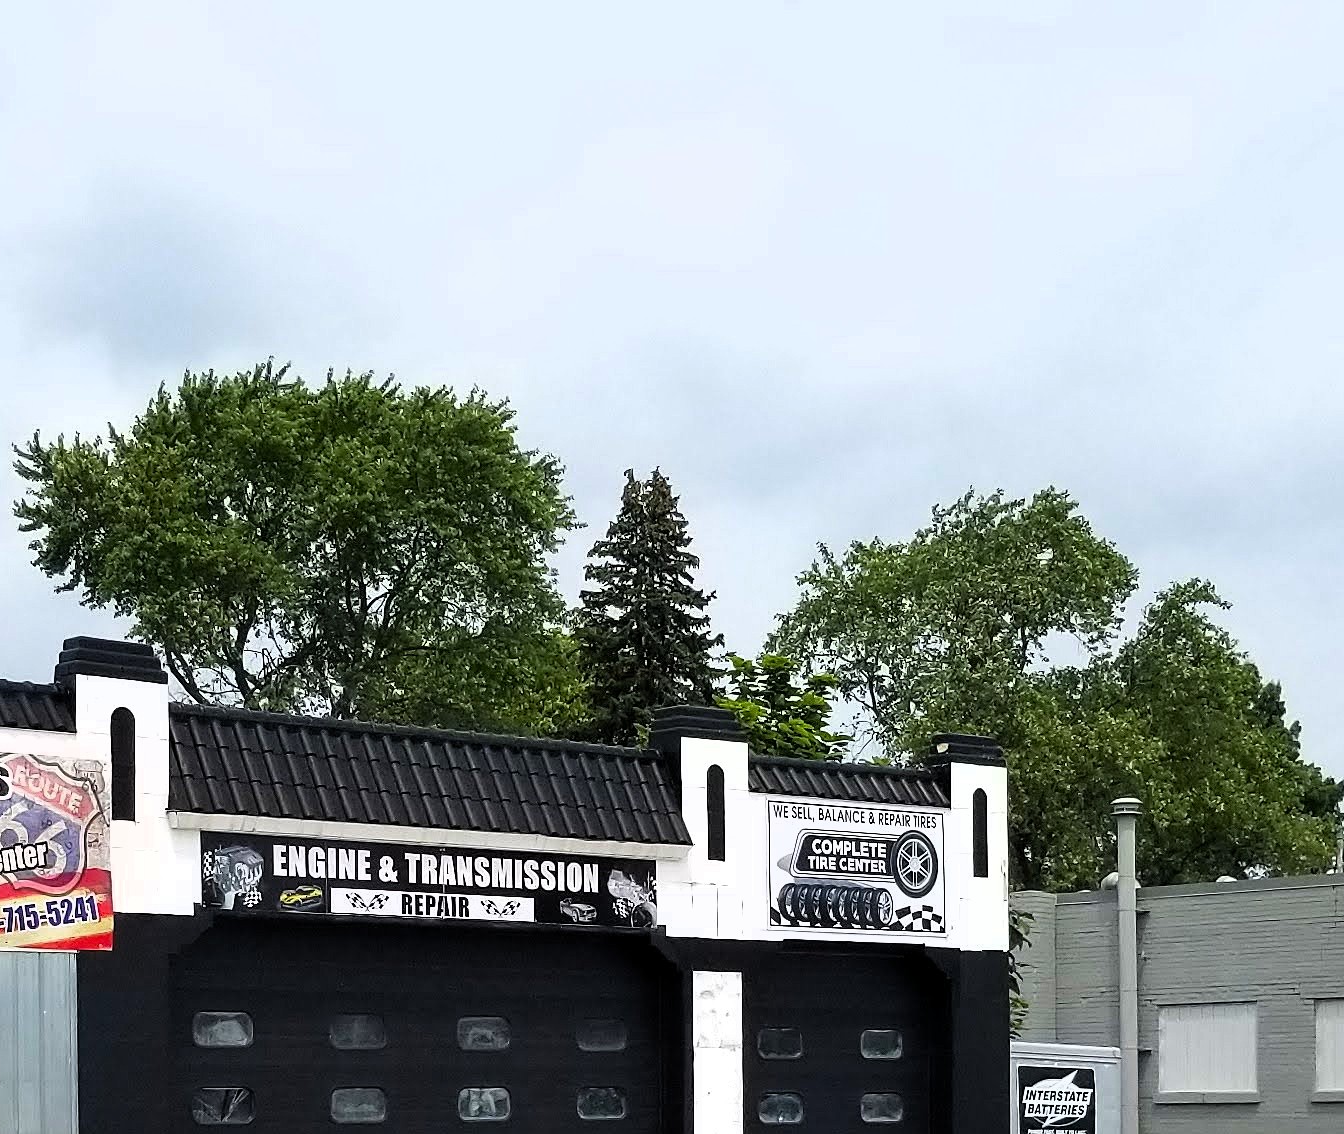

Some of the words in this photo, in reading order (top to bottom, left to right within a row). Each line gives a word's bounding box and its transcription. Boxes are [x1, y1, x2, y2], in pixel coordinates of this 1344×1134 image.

[13, 765, 83, 814] ROUTE
[773, 805, 789, 819] WE
[791, 807, 815, 822] SELL,
[818, 808, 865, 824] BALANCE
[868, 812, 875, 825] &
[878, 813, 911, 827] REPAIR
[913, 815, 937, 828] TIRES
[811, 838, 887, 858] COMPLETE
[272, 844, 372, 881] ENGINE
[378, 855, 399, 882] &
[404, 852, 599, 893] TRANSMISSION
[808, 856, 836, 870] TIRE
[838, 857, 887, 873] CENTER
[400, 893, 469, 918] REPAIR
[1025, 1090, 1089, 1101] INTERSTATE
[1028, 1103, 1084, 1115] BATTERIES
